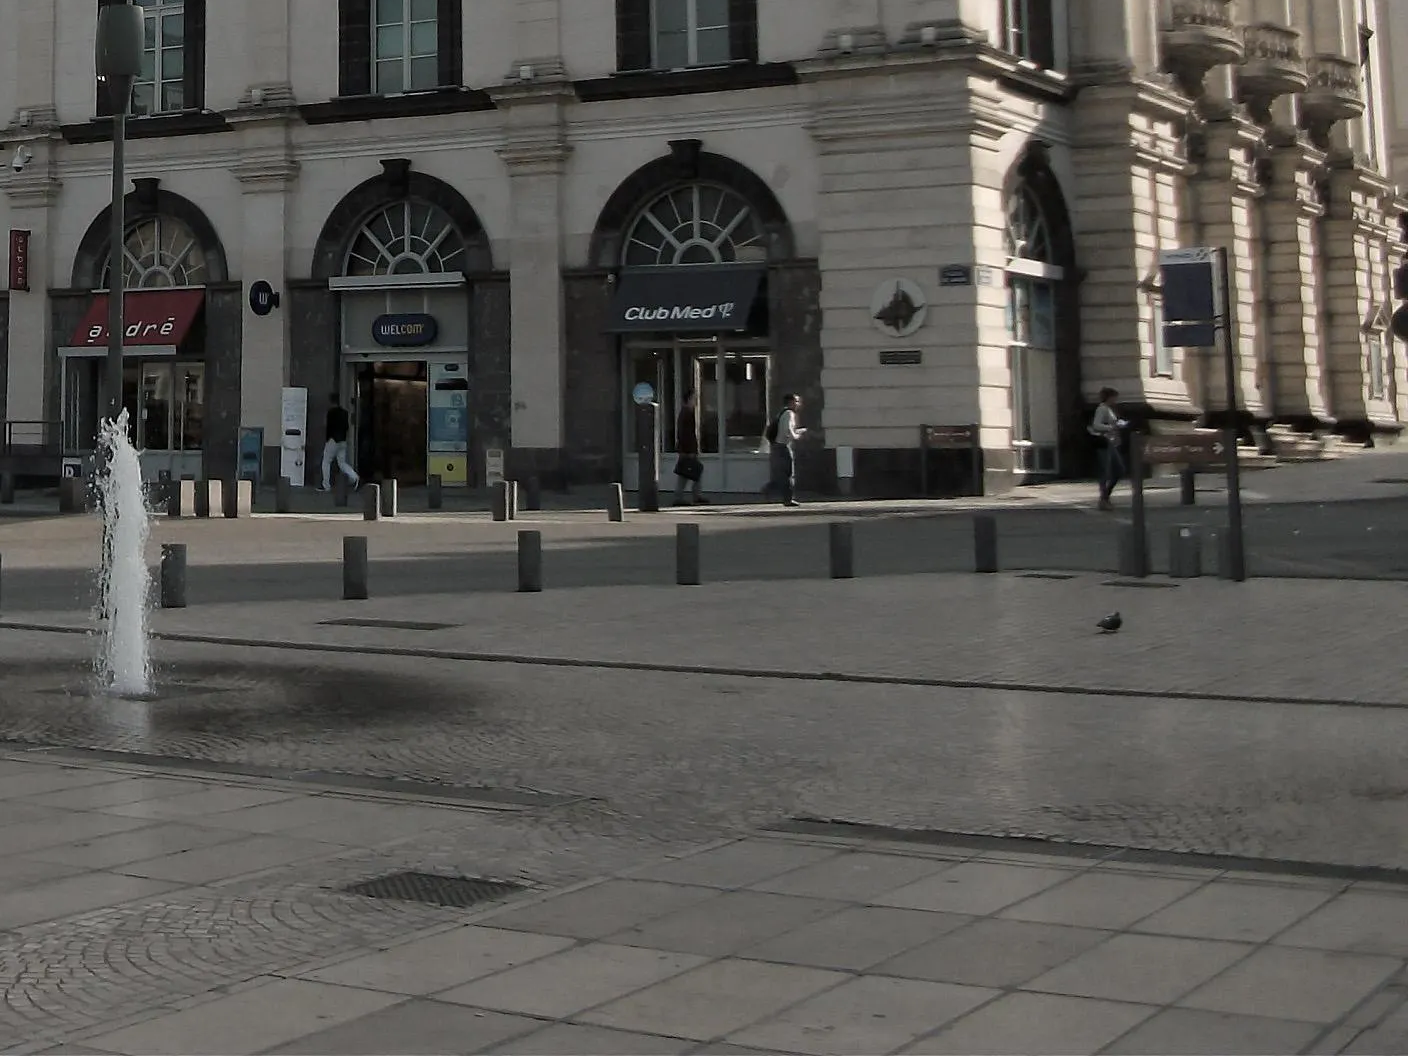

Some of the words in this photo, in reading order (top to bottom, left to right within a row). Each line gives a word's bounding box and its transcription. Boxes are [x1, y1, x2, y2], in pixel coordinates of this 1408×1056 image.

[624, 306, 670, 321] Club
[670, 305, 717, 319] Med
[87, 317, 175, 343] adré
